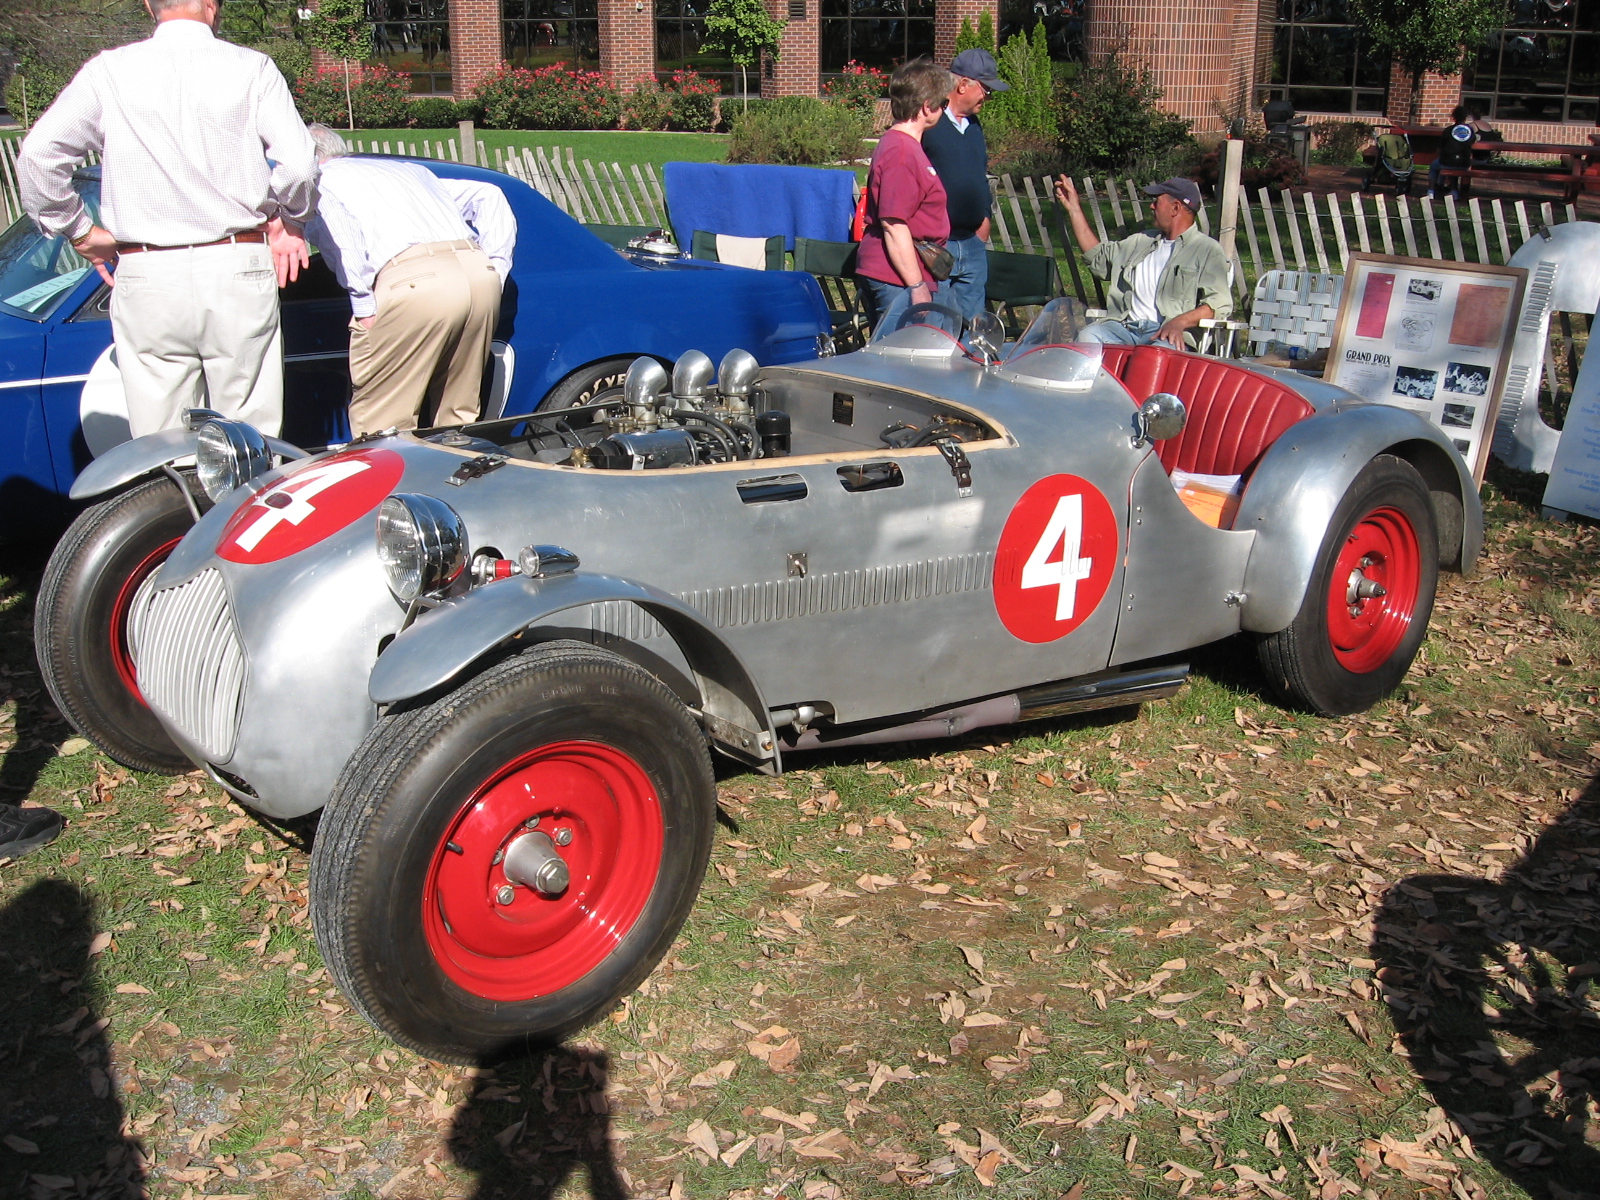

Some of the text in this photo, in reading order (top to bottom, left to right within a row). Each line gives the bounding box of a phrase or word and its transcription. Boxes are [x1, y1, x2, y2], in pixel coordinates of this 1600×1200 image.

[1346, 350, 1372, 361] GRAND
[1373, 353, 1391, 365] PRIX
[235, 460, 372, 552] 4
[1020, 493, 1093, 621] 4
